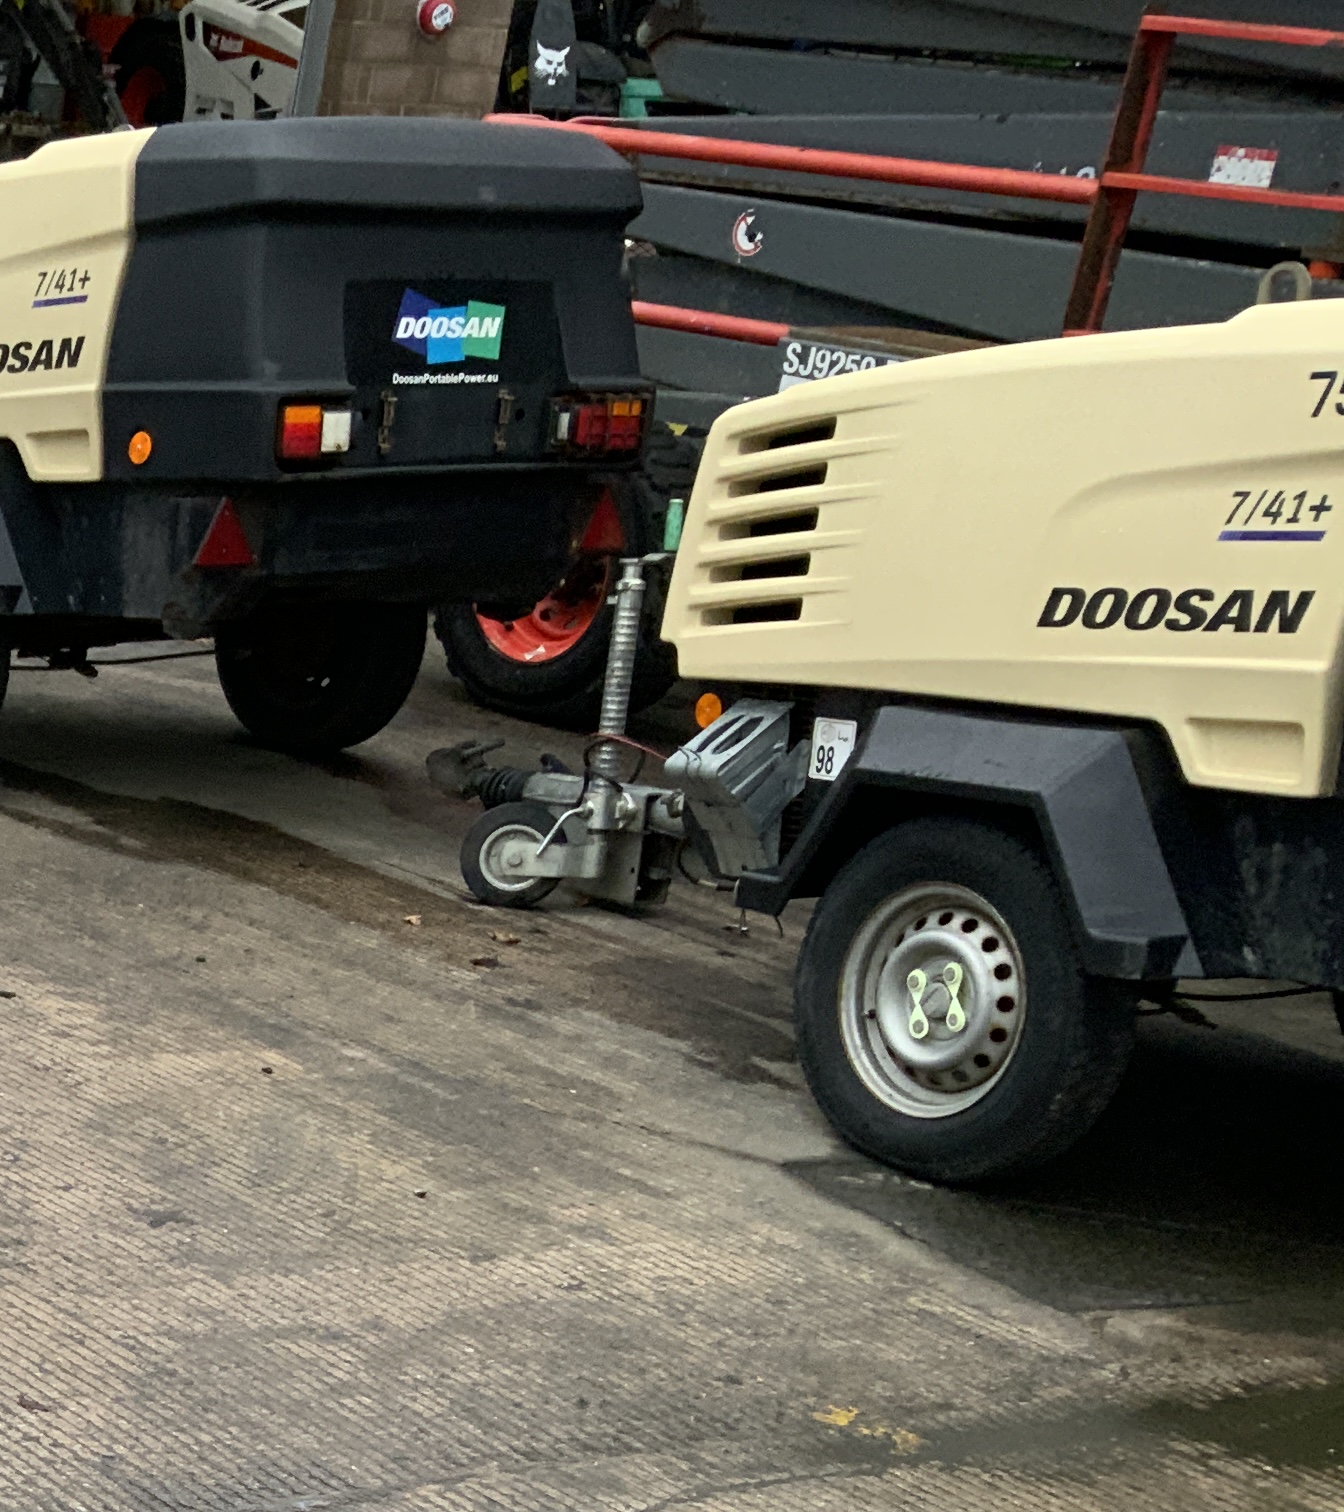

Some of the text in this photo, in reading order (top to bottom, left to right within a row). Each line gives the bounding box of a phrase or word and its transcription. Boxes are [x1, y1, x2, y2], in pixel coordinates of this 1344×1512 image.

[34, 268, 91, 297] 7/41+
[395, 316, 502, 339] DOOSAN
[392, 373, 499, 385] DoosanPortablePower.eu
[1224, 489, 1334, 526] 7/41+
[1036, 587, 1317, 634] DOOSAN
[815, 745, 835, 775] 98
